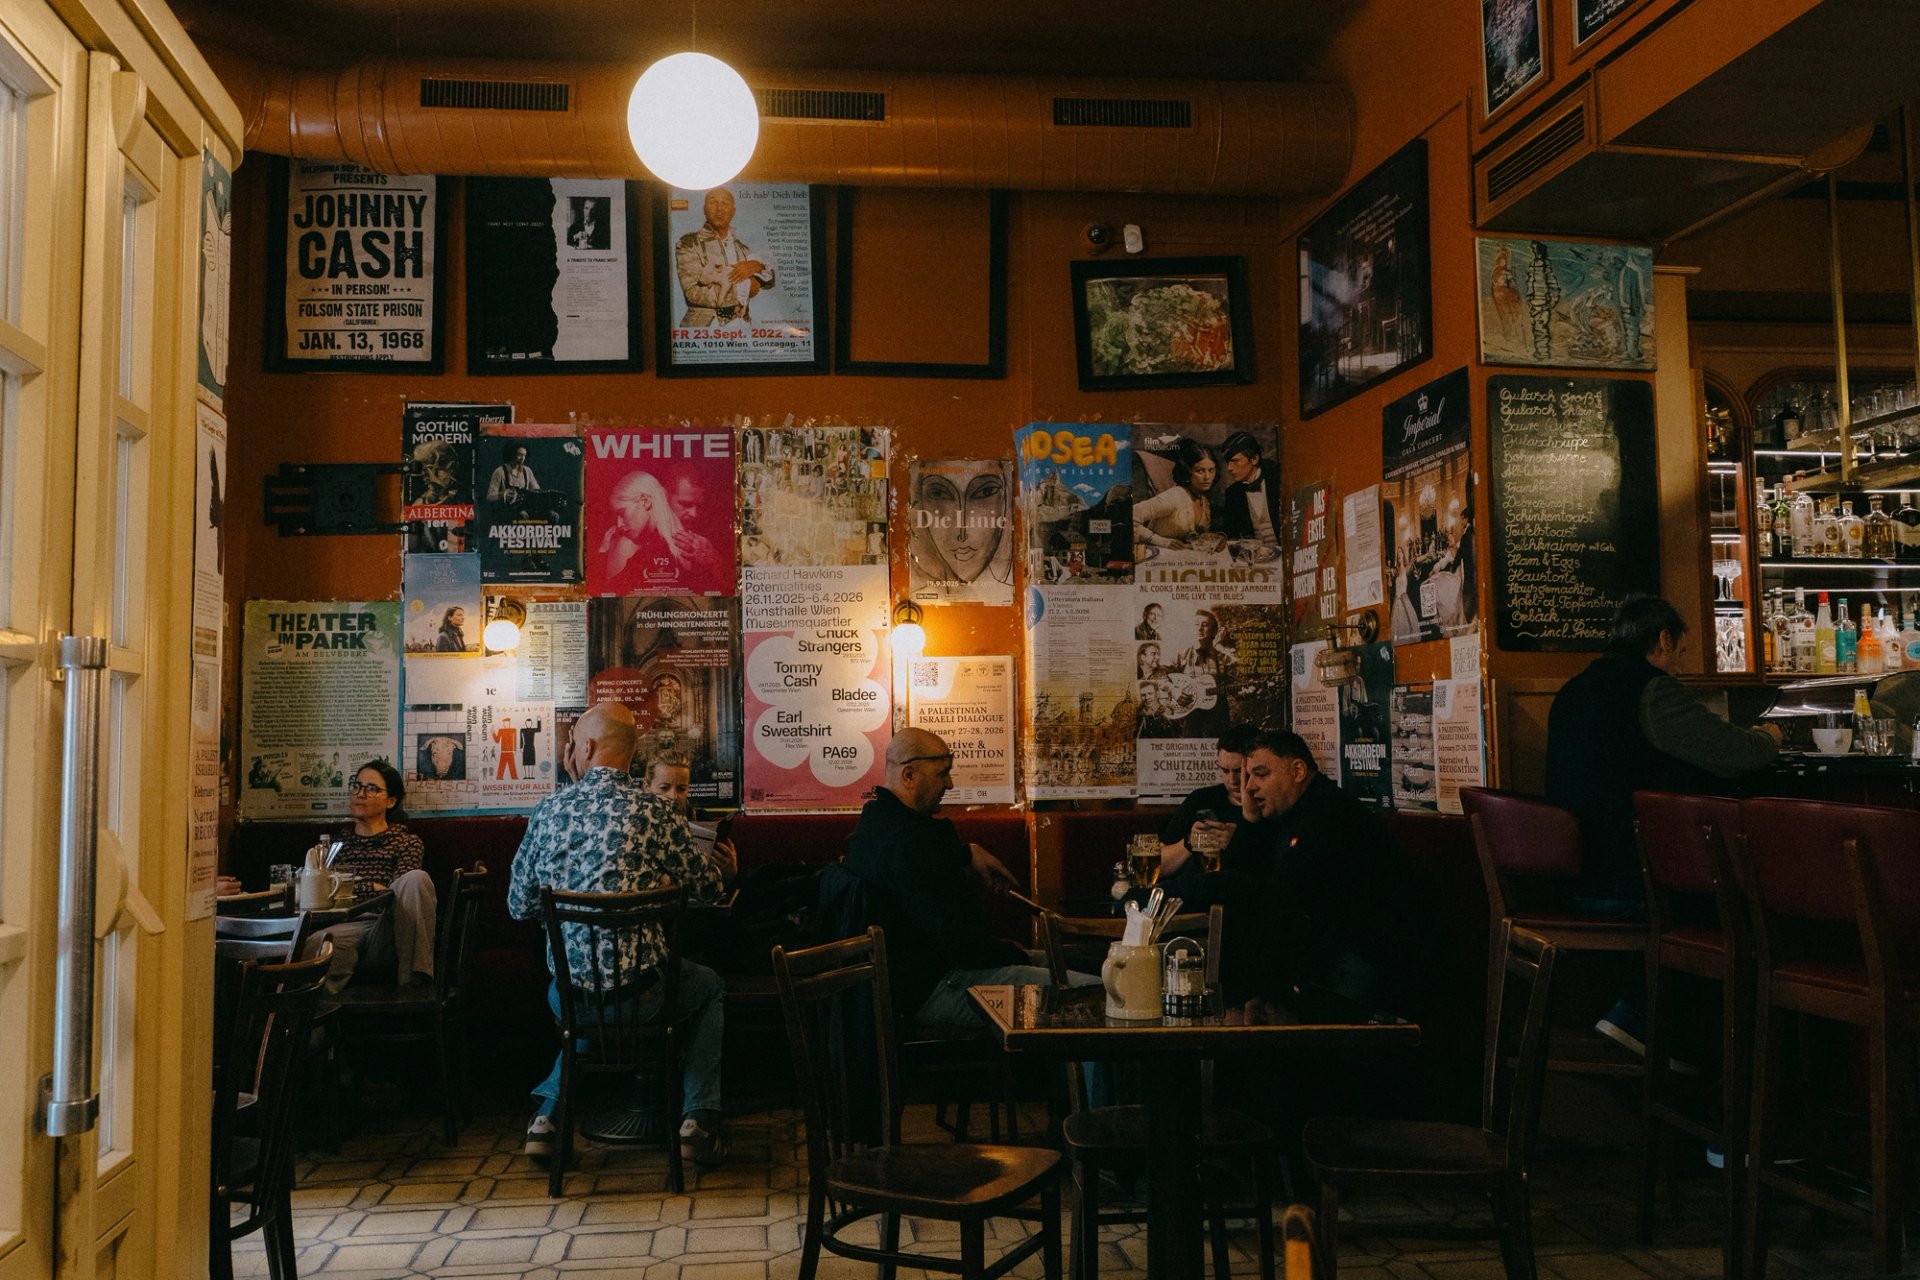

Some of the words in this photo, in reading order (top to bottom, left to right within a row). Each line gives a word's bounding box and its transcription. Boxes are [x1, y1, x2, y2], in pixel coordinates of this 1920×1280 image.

[333, 174, 388, 185] PRESENTS
[739, 191, 750, 199] Ich
[772, 191, 791, 199] Dich
[793, 190, 808, 198] lieb
[294, 194, 427, 229] JOHNNY
[298, 230, 424, 280] CASH
[331, 285, 342, 294] IN
[345, 284, 390, 295] PERSON!
[298, 304, 343, 317] FOLSOM
[346, 304, 379, 317] STATE
[383, 304, 423, 317] PRISON
[672, 329, 689, 339] FR
[693, 329, 747, 341] 23.Sept.
[299, 332, 341, 350] JAN.
[349, 332, 374, 352] 13,
[381, 332, 424, 350] 1968
[673, 341, 700, 349] AERA,
[752, 341, 799, 349] Gonzagag.
[1500, 387, 1556, 406] Gulasch
[1500, 404, 1557, 422] Gulasch
[415, 420, 469, 432] GOTHIC
[1402, 397, 1446, 446] Imperial
[412, 432, 472, 444] MODERN
[1144, 437, 1160, 445] film
[1417, 434, 1443, 450] CONCERT
[1502, 434, 1591, 451] Gulaschsuppe
[591, 434, 730, 459] WHITE
[1314, 489, 1326, 515] DAS
[408, 506, 475, 519] ALBERTINA
[1506, 509, 1595, 524] Schinkentoast
[915, 509, 951, 530] Die
[488, 525, 571, 538] AKKORDEON
[1308, 516, 1326, 544] ERSTE
[1505, 524, 1577, 538] Teufelstoast
[499, 537, 562, 549] FESTIVAL
[1508, 553, 1541, 567] Ham
[1543, 553, 1550, 567] &
[1552, 554, 1581, 572] Eggs
[745, 569, 790, 580] Richard
[794, 568, 844, 580] Hawkins
[1322, 566, 1336, 592] DER
[1508, 568, 1578, 584] Haustorte
[746, 581, 822, 592] Potentialities
[1294, 571, 1316, 600] MUSEUM
[1506, 582, 1596, 600] Hausgemachter
[1172, 592, 1188, 600] LONG
[1192, 592, 1206, 600] LIVE
[1208, 592, 1222, 600] THE
[1224, 592, 1244, 600] BLUES
[746, 605, 808, 616] Kunsthalle
[811, 604, 840, 615] Wien
[1320, 593, 1336, 620] WELT
[636, 610, 729, 620] FRÜHLINGSKONZERTE
[1510, 609, 1560, 628] Gebäck
[268, 613, 376, 632] THEATER
[657, 620, 729, 628] MINORITENKIRCHE
[746, 617, 852, 630] Museumsquartier
[1540, 624, 1571, 638] incl.
[278, 633, 294, 645] IM
[295, 632, 367, 650] PARK
[798, 640, 862, 655] Strangers
[313, 650, 368, 658] BELVEDERE
[774, 661, 823, 677] Tommy
[784, 674, 818, 688] Cash
[832, 688, 877, 701] Bladee
[928, 706, 988, 714] PALESTINIAN
[777, 711, 802, 723] Earl
[958, 714, 1004, 722] DIALOGUE
[762, 724, 832, 738] Sweatshirt
[1442, 726, 1470, 734] PALESTINIAN
[978, 740, 986, 749] &
[1166, 743, 1198, 751] ORIGINAL
[823, 747, 858, 759] PA69
[952, 750, 1004, 759] GNITION
[1344, 744, 1386, 759] AKKORDEON
[1153, 760, 1220, 771] SCHUTZHAUS
[1350, 758, 1381, 771] FESTIVAL
[1438, 756, 1464, 764] Narrative
[1175, 772, 1217, 781] 28.2.2026
[1404, 764, 1424, 777] Raum
[1440, 766, 1479, 774] RECOGNITION
[482, 784, 514, 792] WISSEN
[515, 782, 532, 790] FÜR
[533, 782, 552, 790] ALLE
